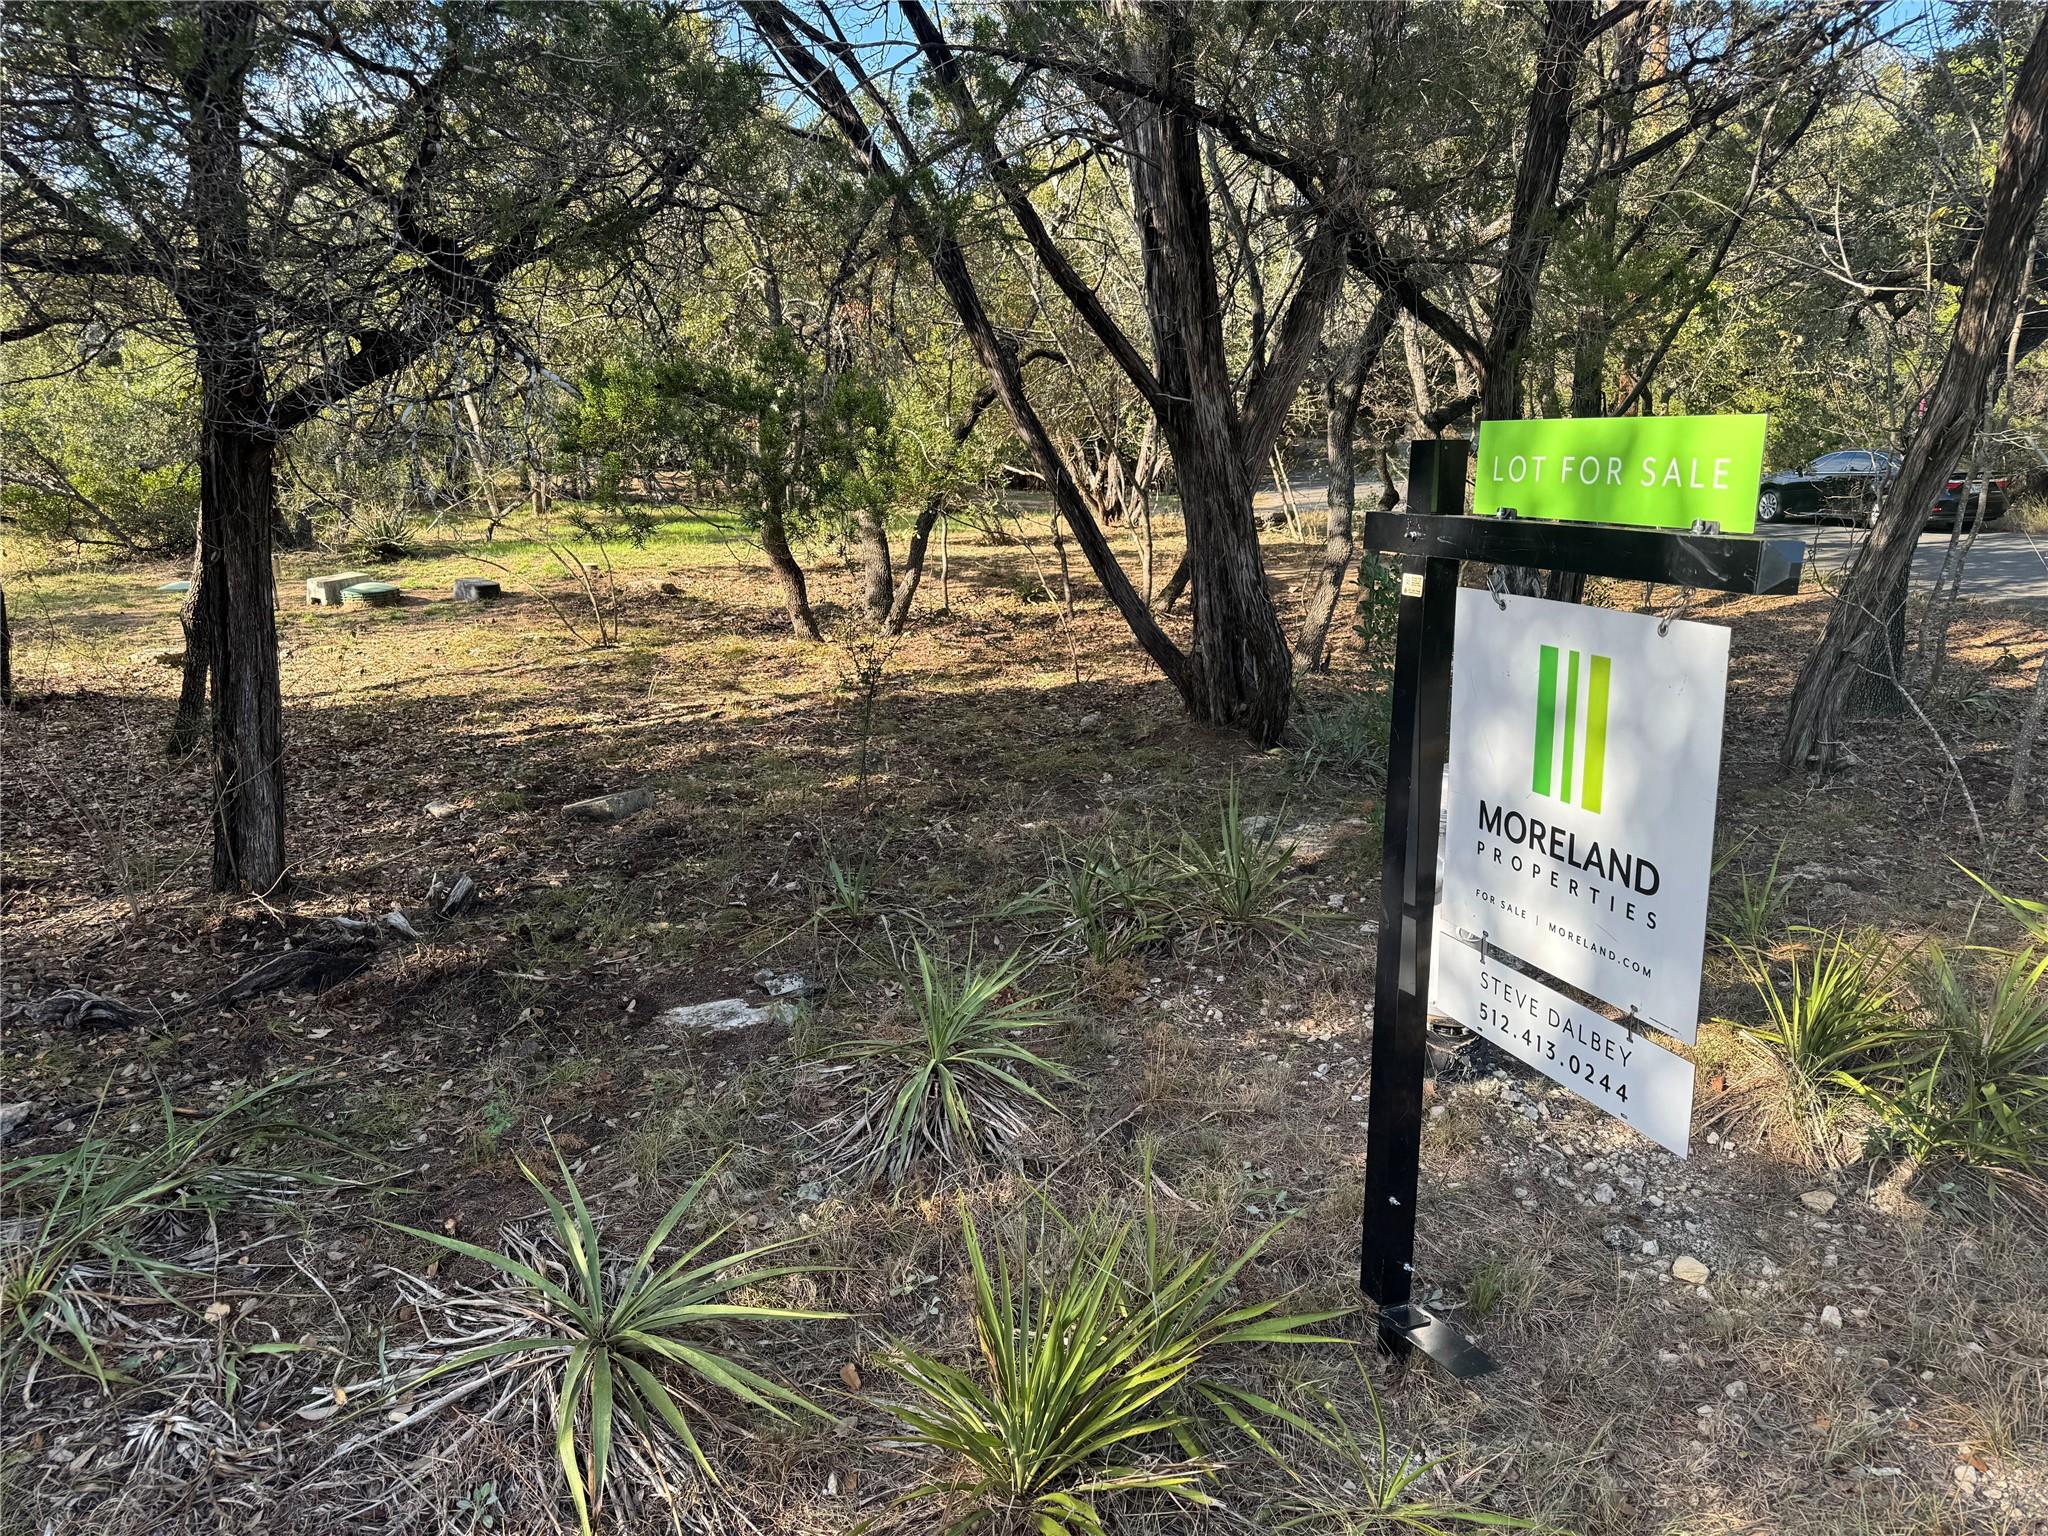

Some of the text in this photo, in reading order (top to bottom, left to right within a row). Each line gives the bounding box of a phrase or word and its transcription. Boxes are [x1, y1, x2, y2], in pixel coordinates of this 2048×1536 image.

[1492, 455, 1731, 489] LOT FOR SALE
[1477, 841, 1657, 930] PROPERTIES
[1479, 800, 1660, 896] MORELAND
[1475, 889, 1652, 979] FOR SALE MORELAND.COM
[1479, 1002, 1628, 1103] 512.413.0244
[1480, 972, 1632, 1068] STEVE DALBEY
